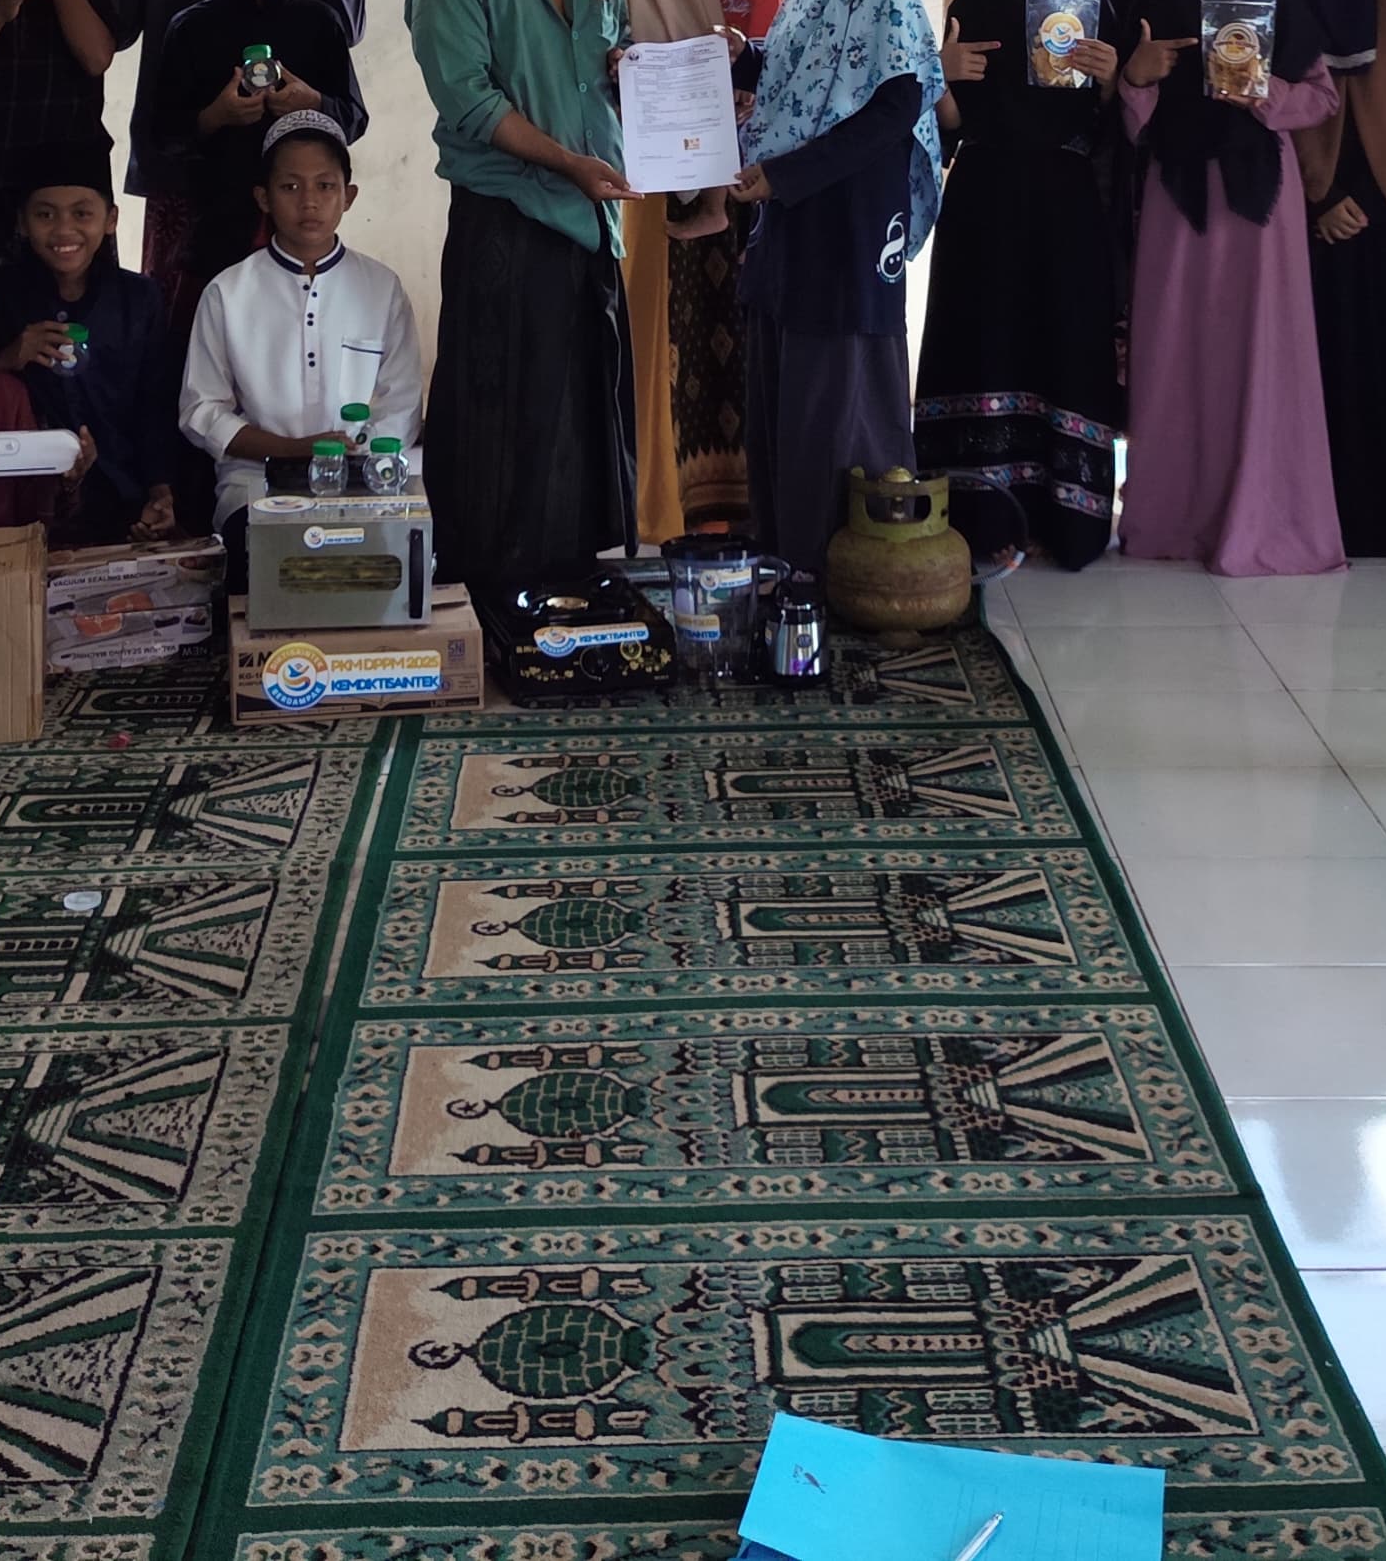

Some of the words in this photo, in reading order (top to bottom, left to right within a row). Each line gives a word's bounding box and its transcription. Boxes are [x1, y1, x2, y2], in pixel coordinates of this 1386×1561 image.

[53, 577, 86, 588] VACUUM
[88, 574, 121, 584] SEALING
[331, 659, 363, 672] PKM
[364, 657, 406, 671] DPPM
[406, 656, 439, 669] 2025
[271, 686, 324, 706] BERDAMPAK
